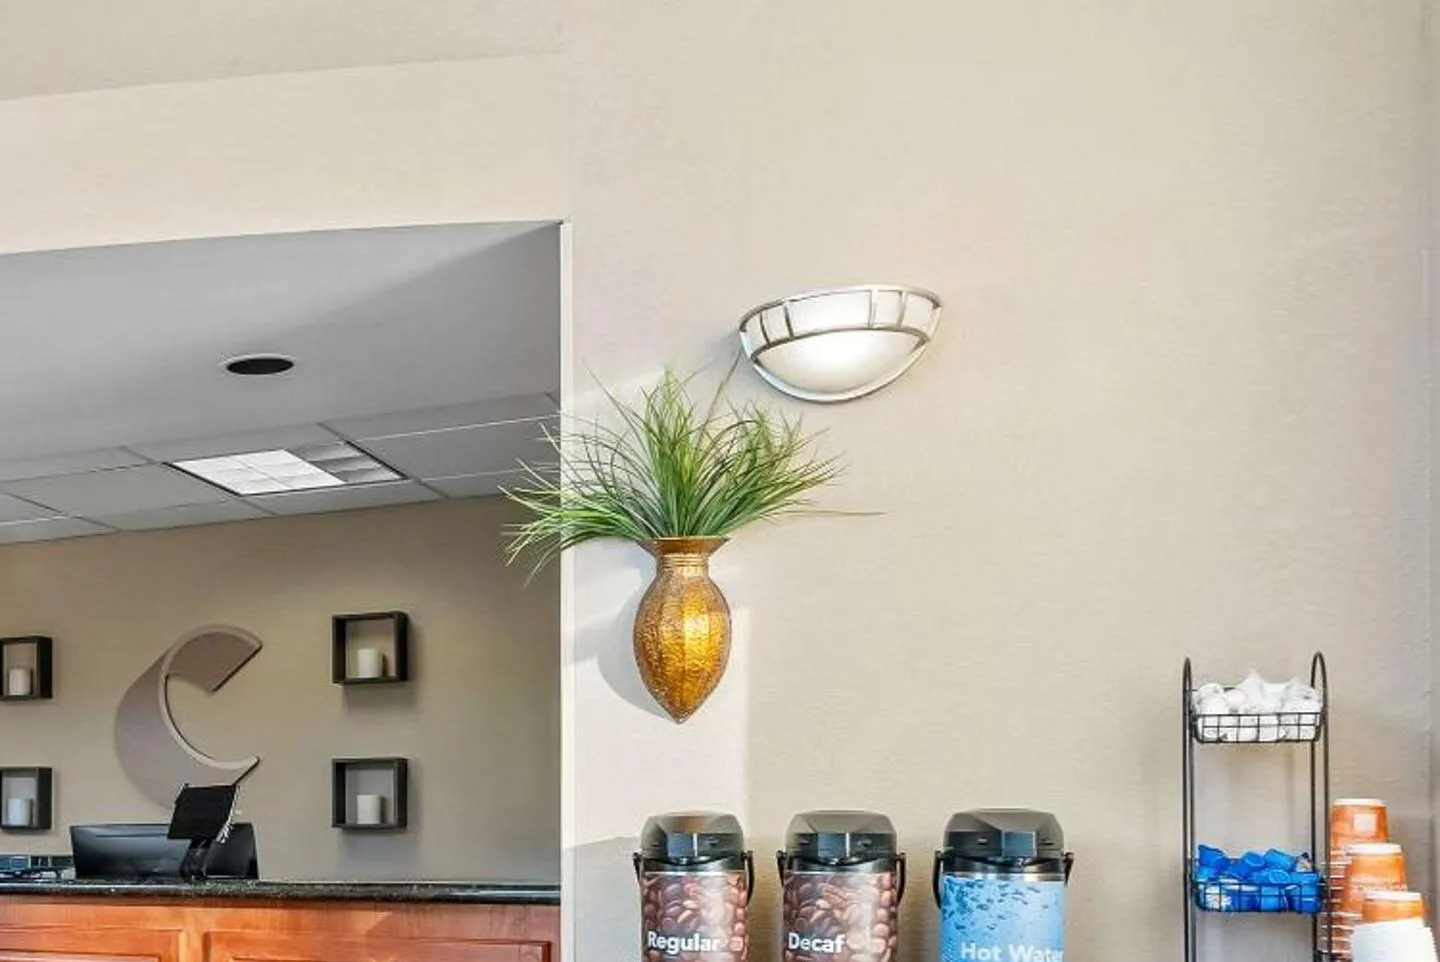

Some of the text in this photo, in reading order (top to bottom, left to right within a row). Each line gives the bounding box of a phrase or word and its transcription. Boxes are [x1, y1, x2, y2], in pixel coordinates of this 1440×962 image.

[647, 931, 721, 954] Regular
[788, 932, 845, 953] Decaf
[961, 941, 1002, 962] Hot
